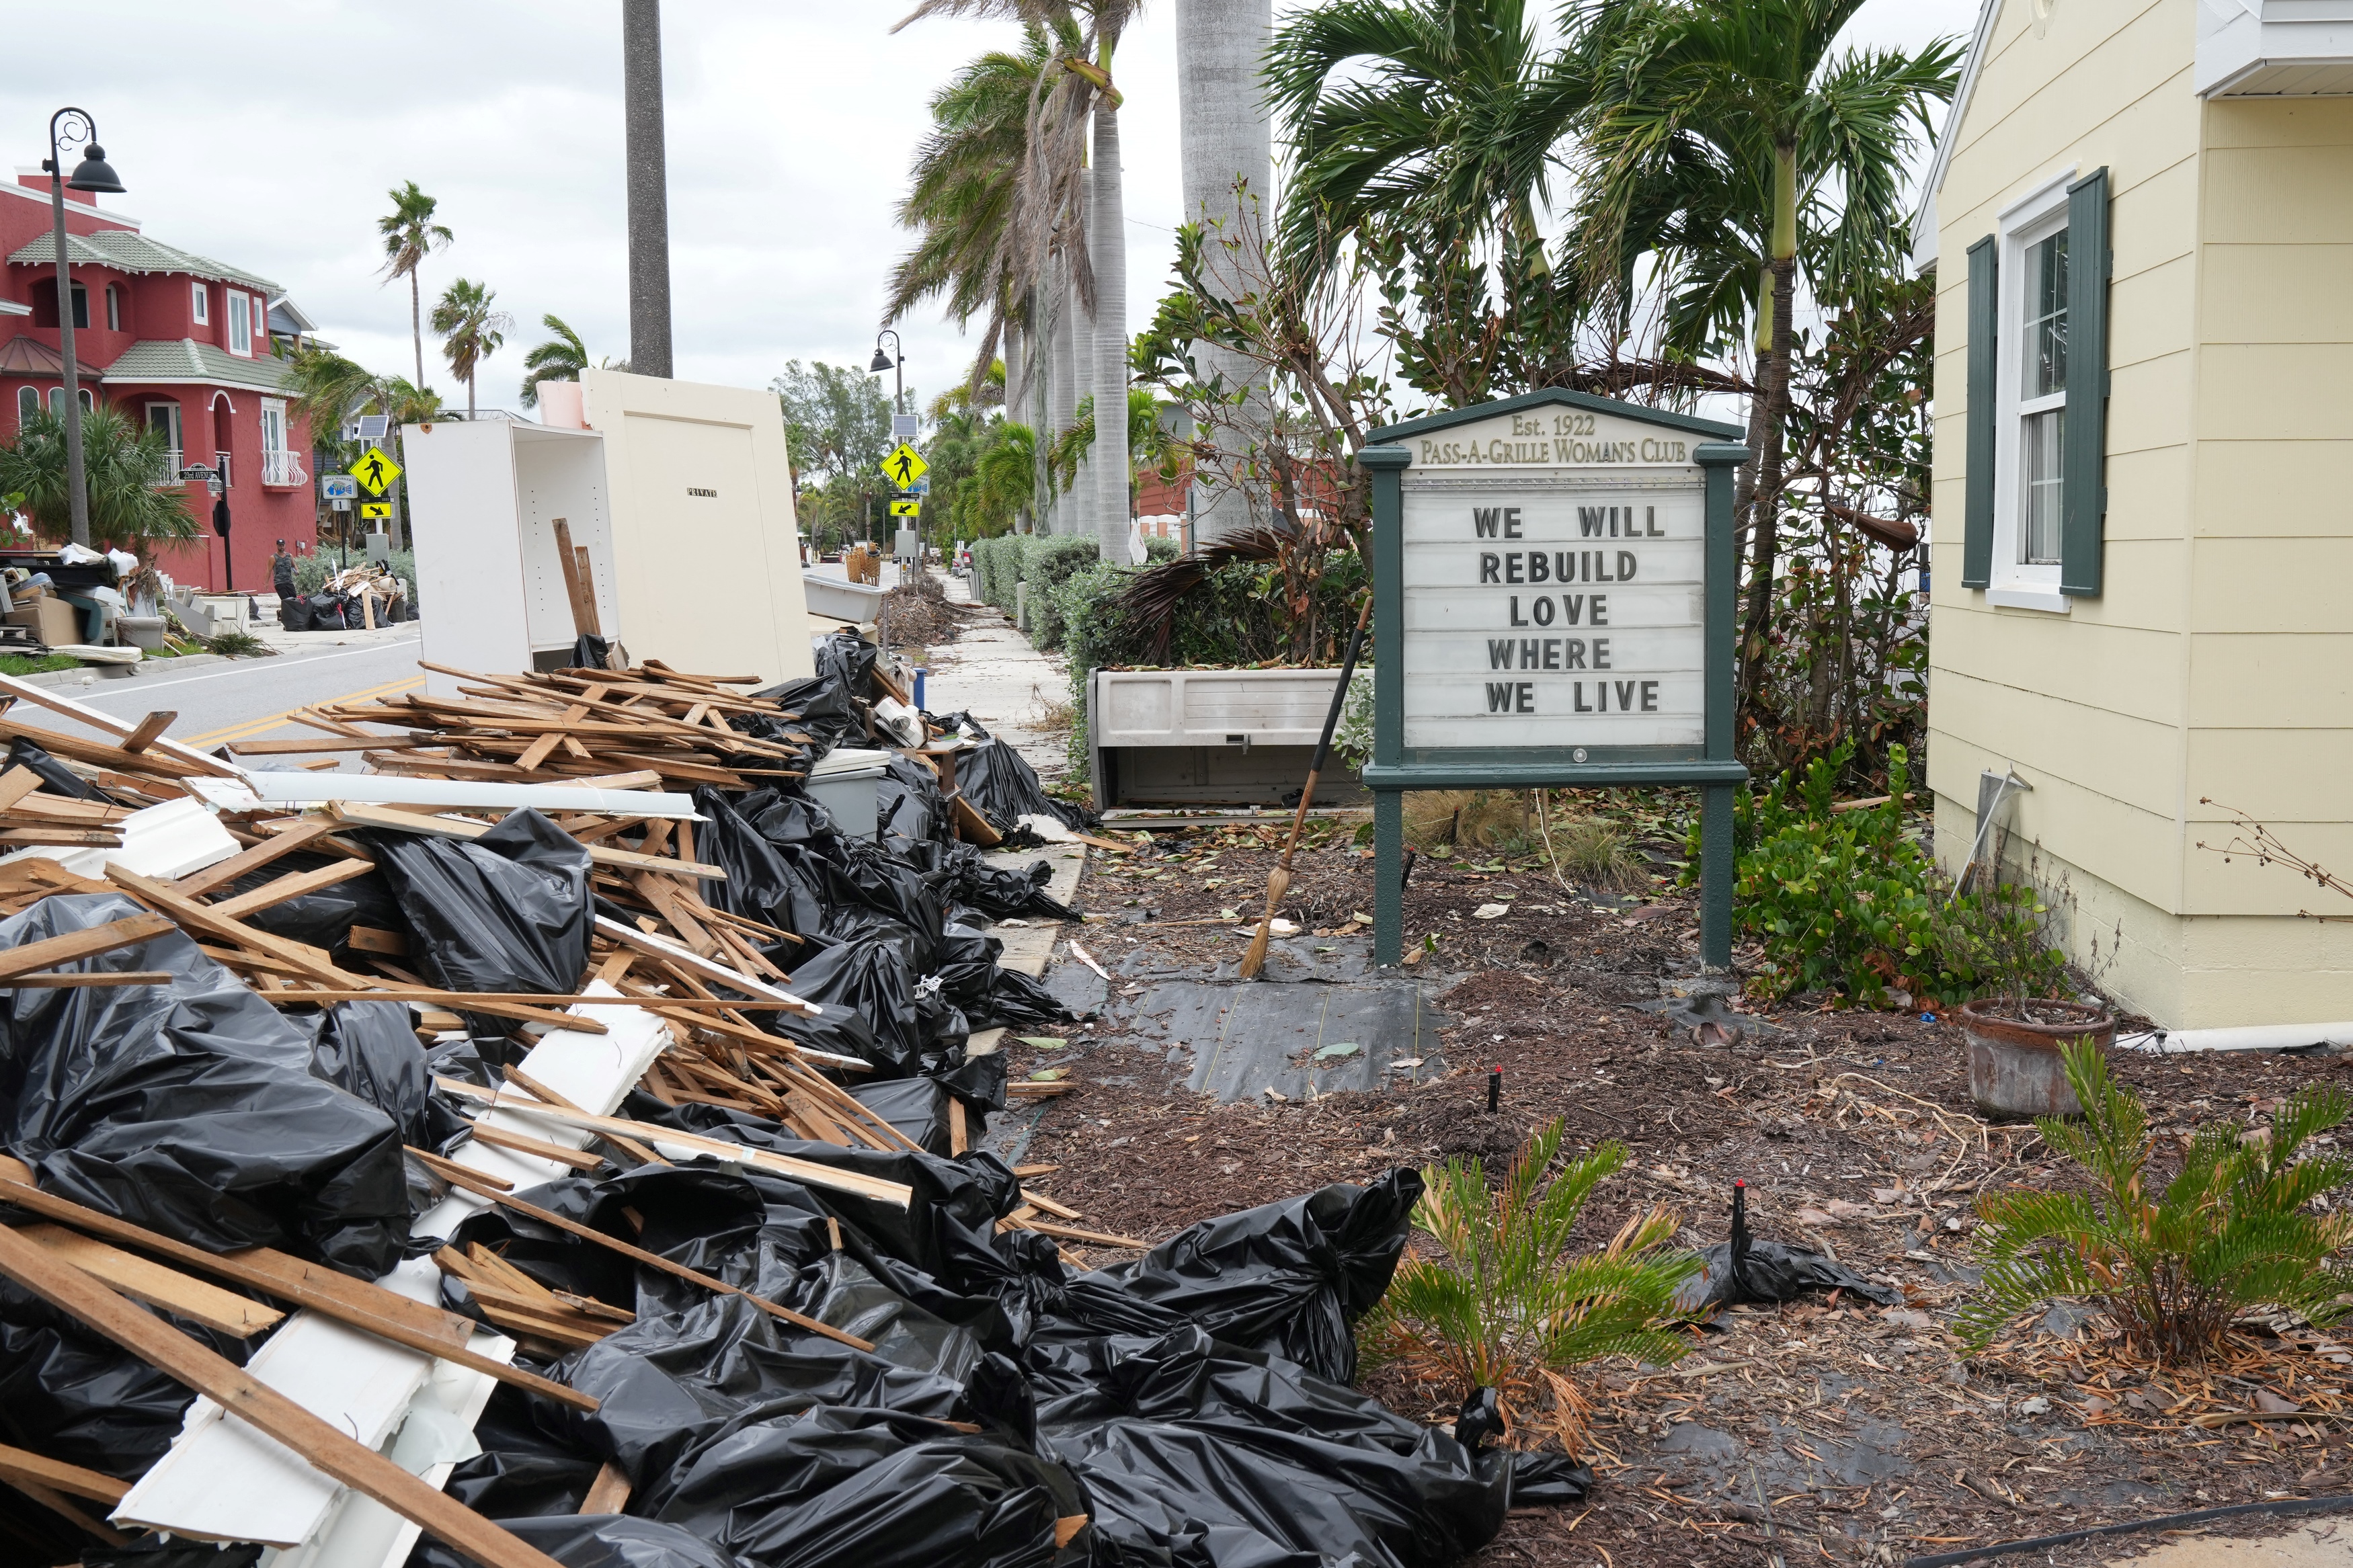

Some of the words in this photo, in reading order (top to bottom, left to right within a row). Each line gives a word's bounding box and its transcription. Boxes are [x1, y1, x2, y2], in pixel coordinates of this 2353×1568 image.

[1513, 415, 1546, 436] Est.
[1554, 415, 1595, 435] 1922
[1421, 439, 1550, 464] PASS-A-GRILLE
[1554, 438, 1636, 462] WOMAN'S
[1641, 438, 1686, 462] CLUB
[184, 471, 194, 479] 23rd
[338, 501, 344, 510] 1
[687, 488, 717, 497] PRIVATE
[1473, 507, 1523, 538] WE
[1578, 505, 1665, 538] WILL
[1480, 550, 1637, 584] REBUILD
[1510, 594, 1608, 626] LOVE
[1488, 638, 1611, 669] WHERE
[1485, 682, 1535, 712] WE
[1574, 680, 1659, 712] LIVE
